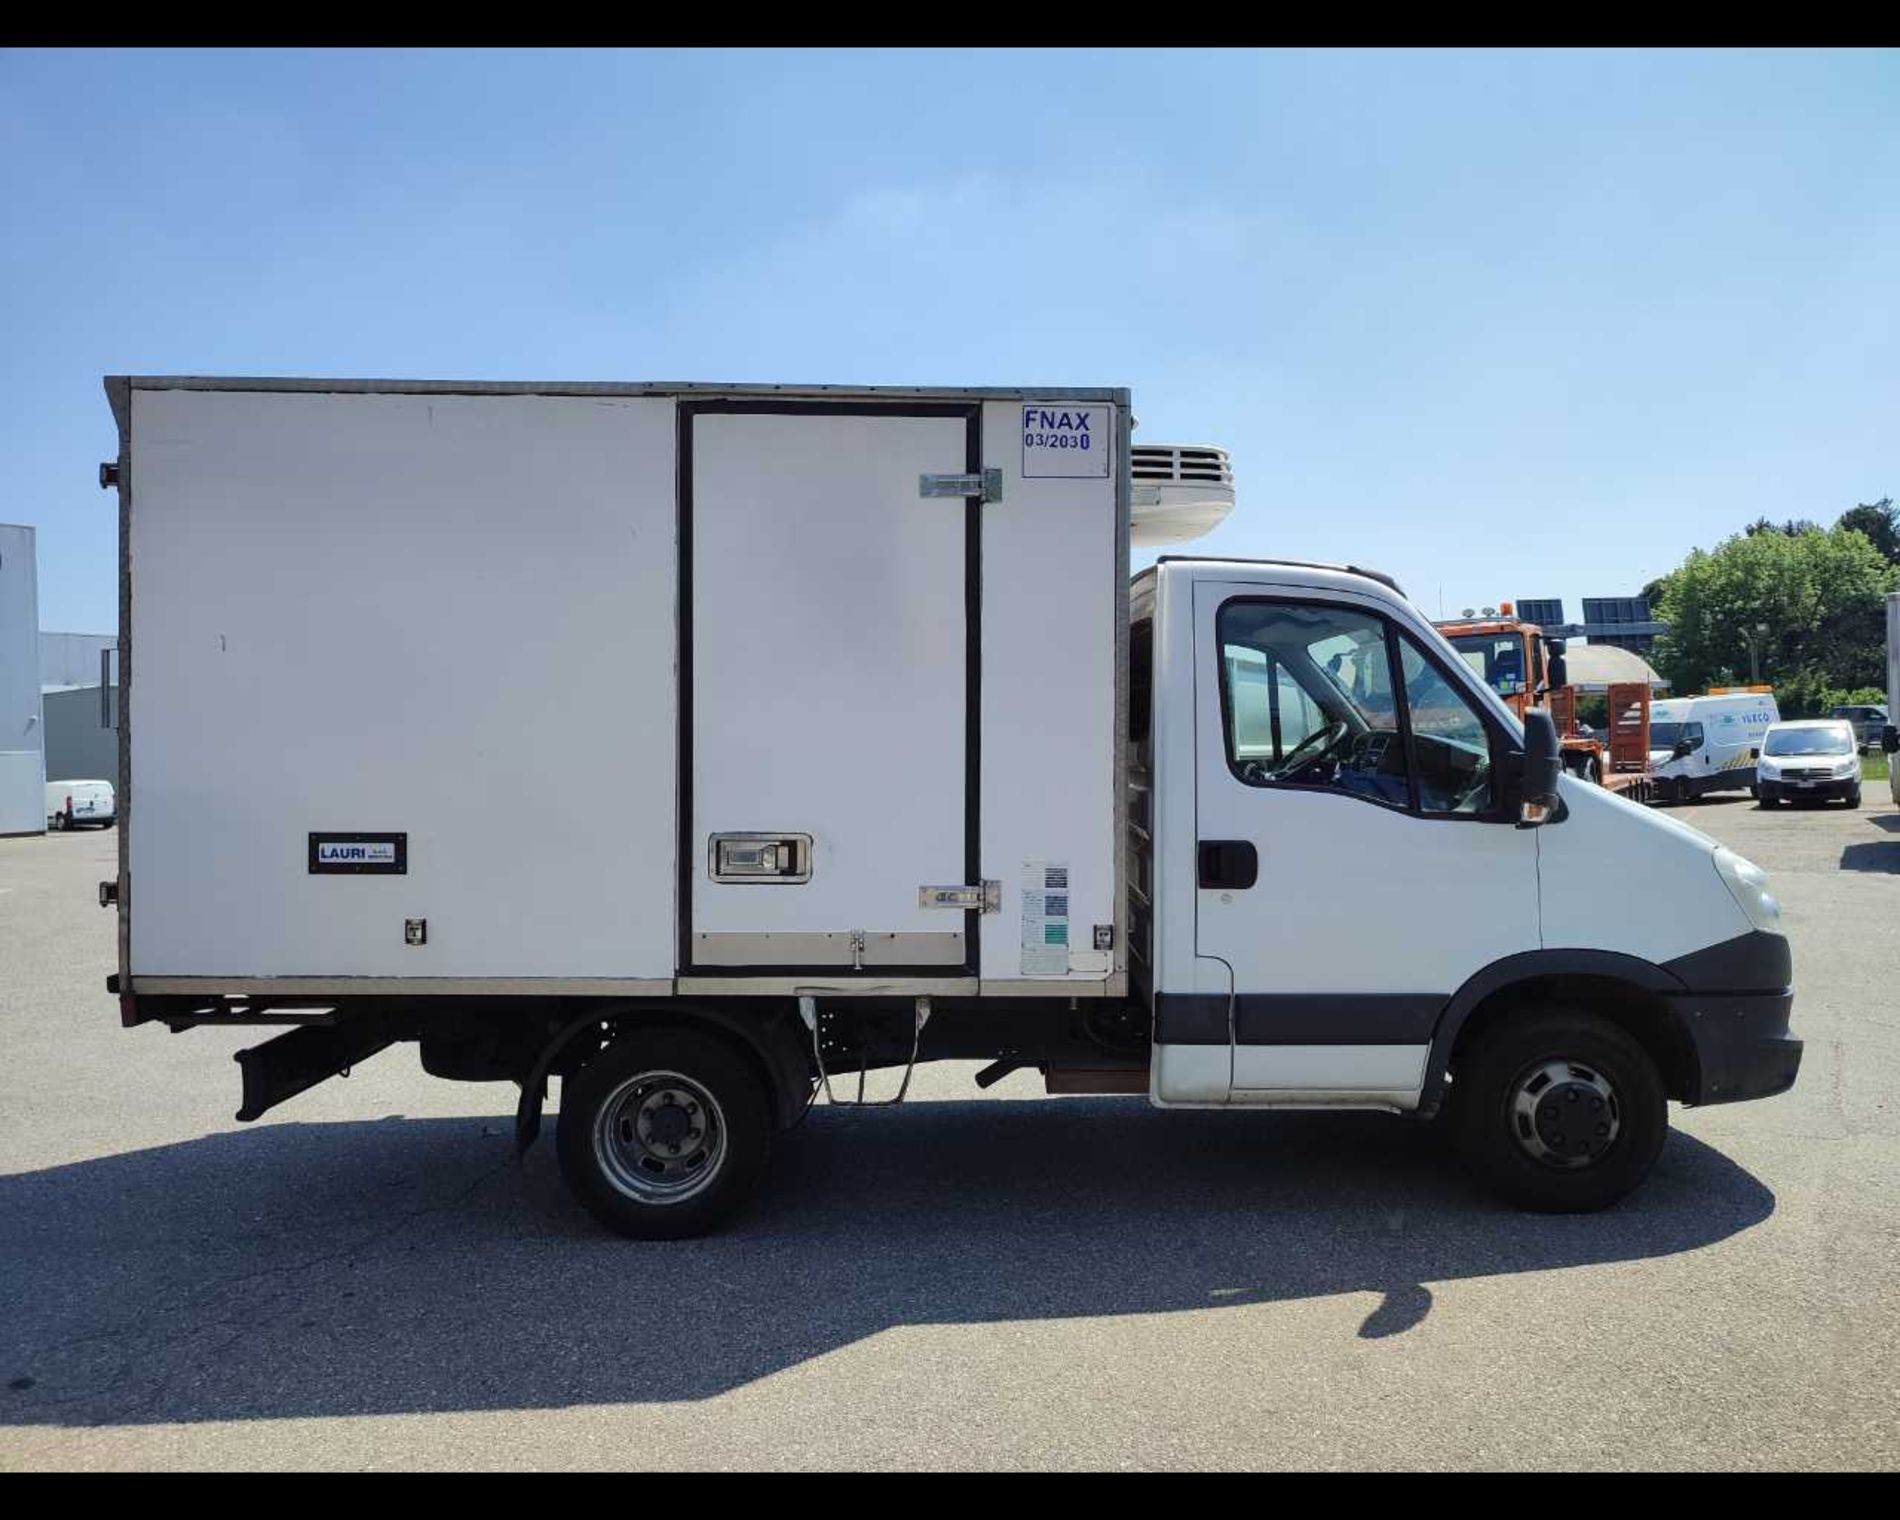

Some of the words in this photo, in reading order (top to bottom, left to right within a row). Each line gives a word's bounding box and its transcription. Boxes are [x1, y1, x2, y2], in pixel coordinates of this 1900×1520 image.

[1025, 410, 1090, 431] FNAX
[1025, 433, 1090, 450] 03/2030
[320, 847, 366, 859] LAURI
